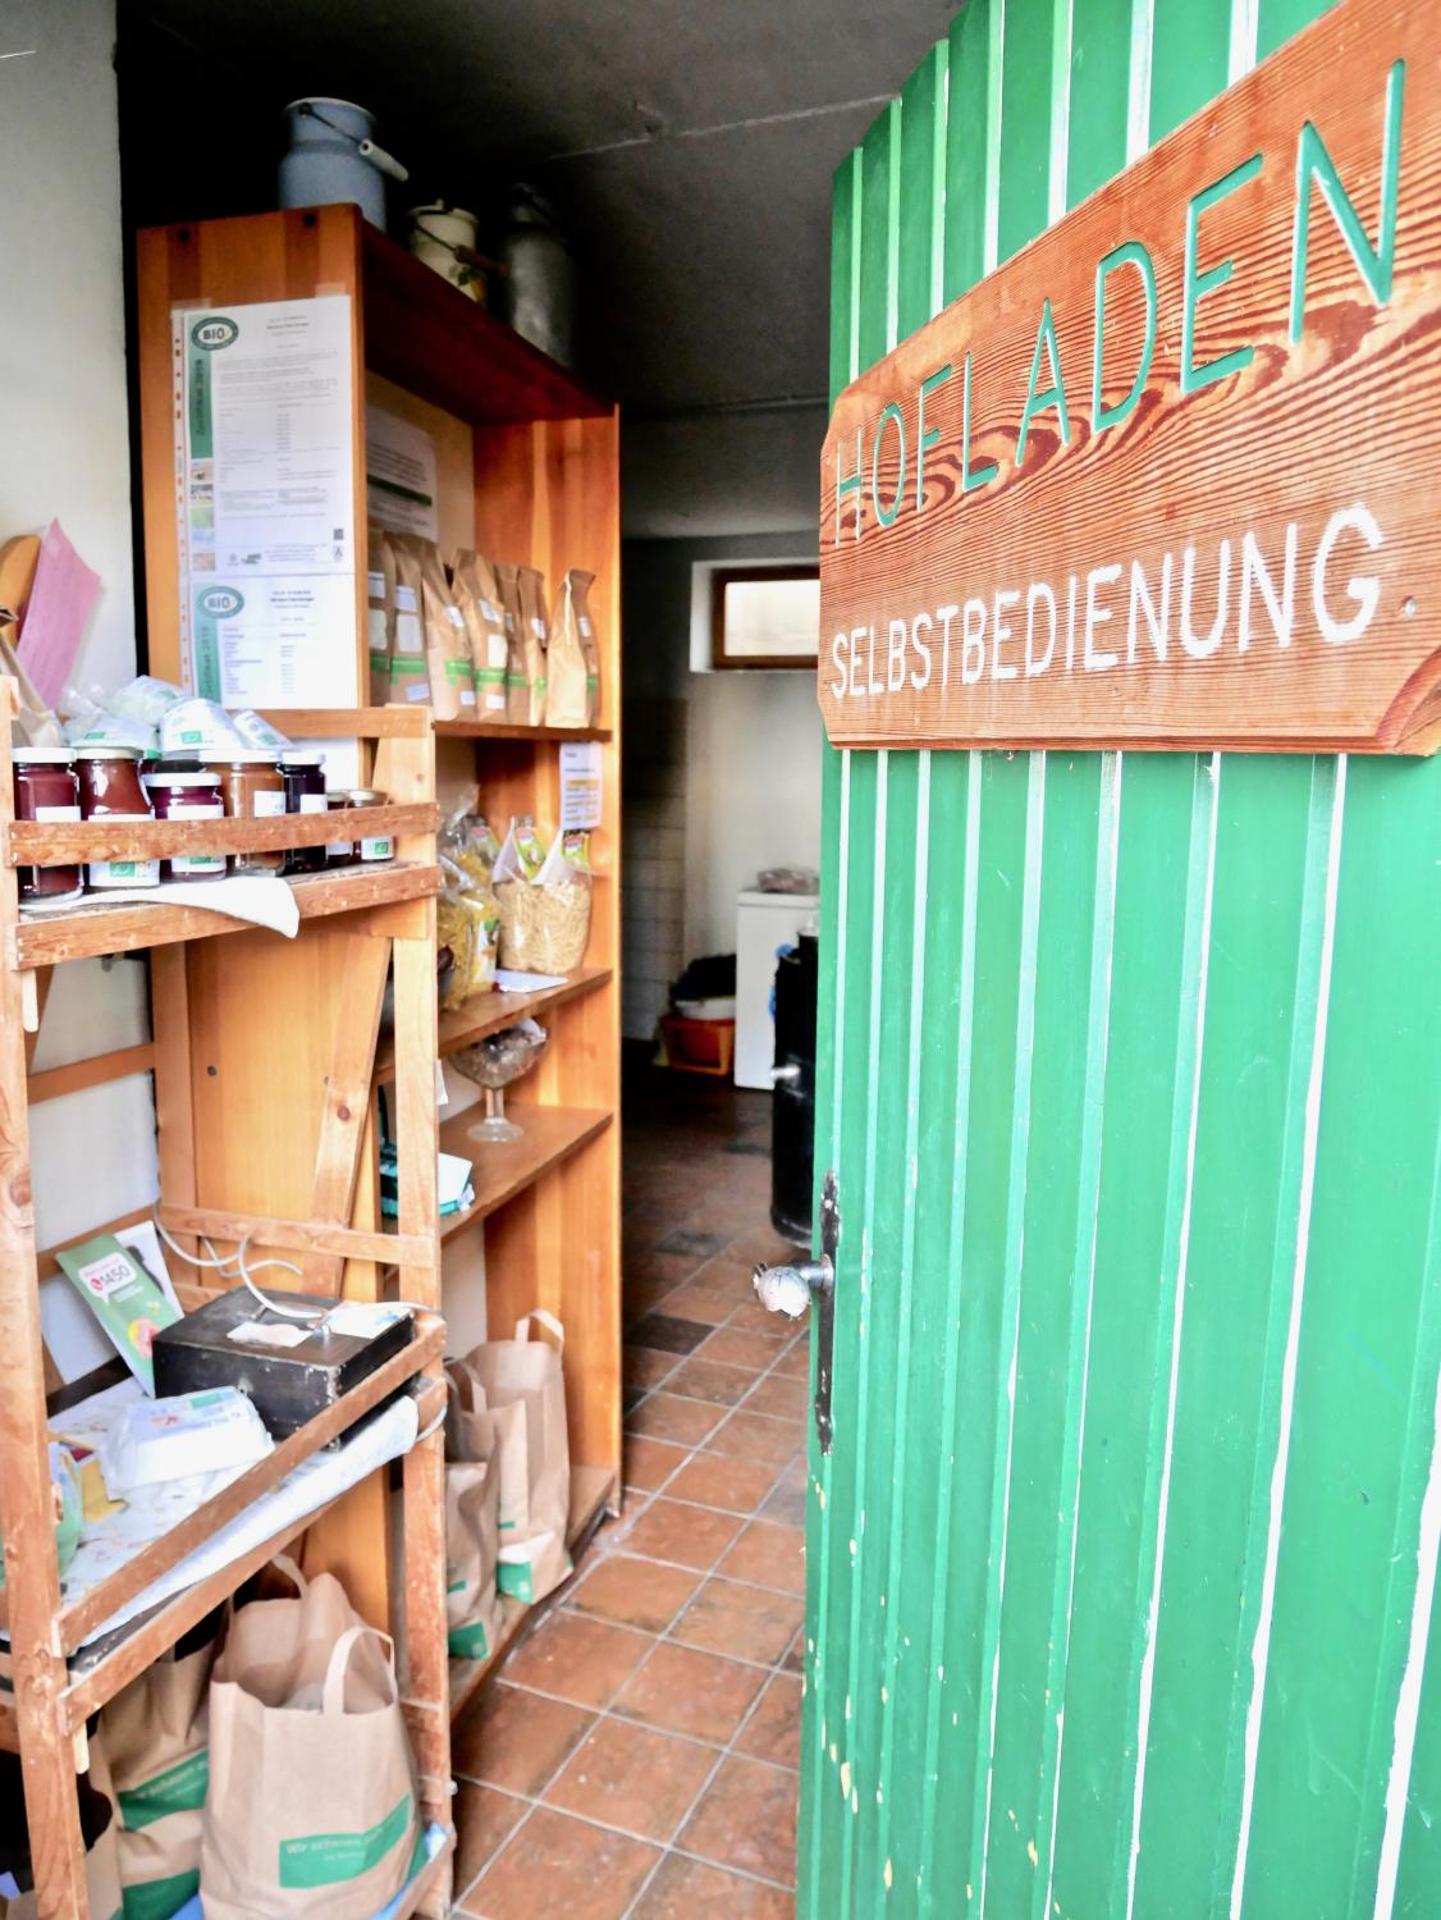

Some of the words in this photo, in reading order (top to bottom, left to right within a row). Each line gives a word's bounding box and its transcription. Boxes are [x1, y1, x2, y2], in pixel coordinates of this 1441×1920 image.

[203, 327, 225, 340] BIO
[836, 57, 1405, 548] HOFLADEN
[208, 596, 230, 608] BIO
[831, 503, 1384, 699] SELBSTBEDIENUNG
